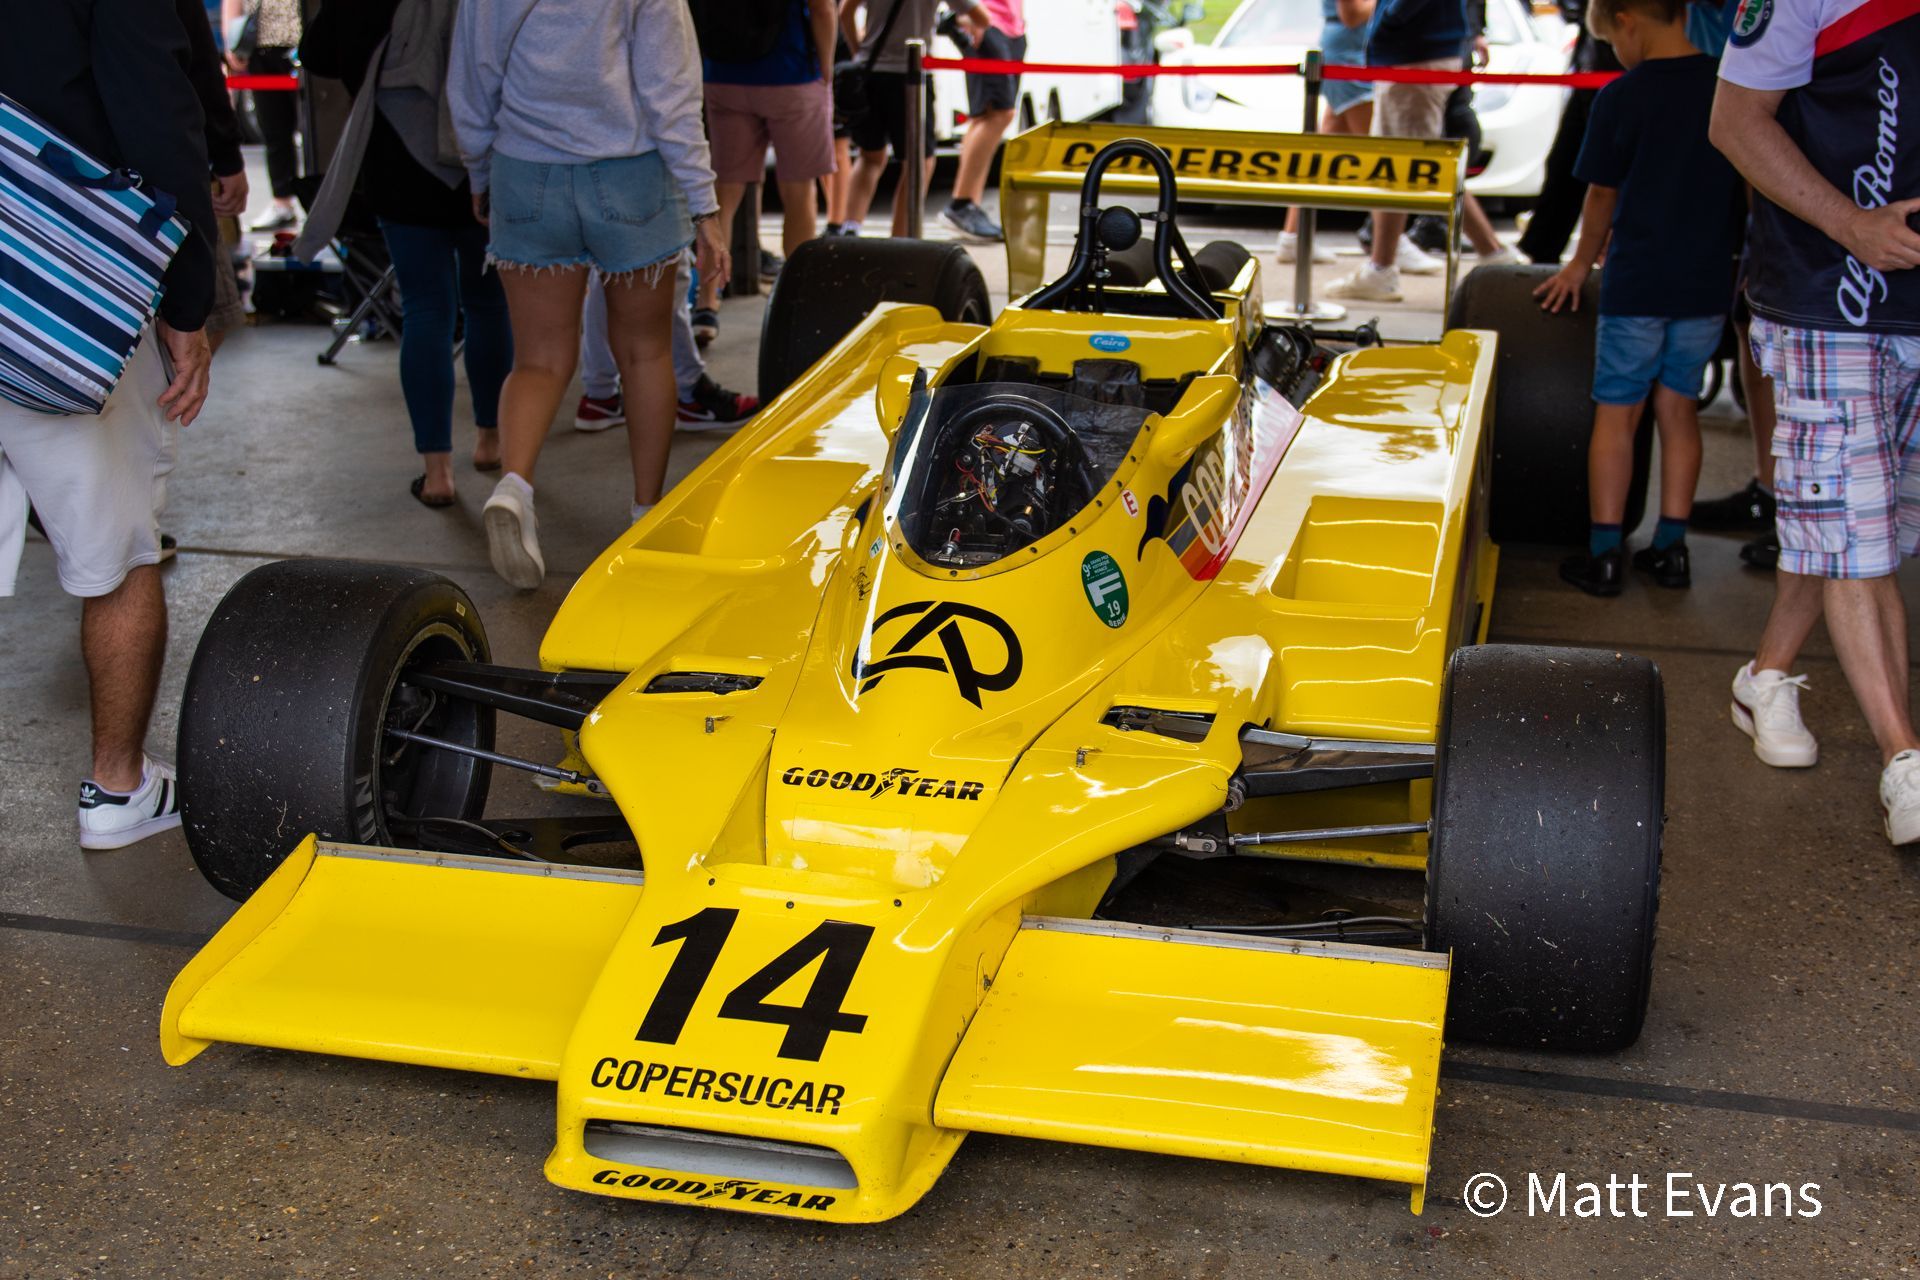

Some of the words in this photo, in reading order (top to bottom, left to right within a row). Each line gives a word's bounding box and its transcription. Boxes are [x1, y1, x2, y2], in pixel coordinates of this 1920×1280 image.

[1853, 57, 1899, 210] Romeo
[1062, 141, 1442, 186] CERSUCAR
[1086, 571, 1122, 607] F
[1107, 600, 1121, 618] 19
[634, 907, 876, 1062] 14
[591, 1057, 845, 1115] COPERSUCAR
